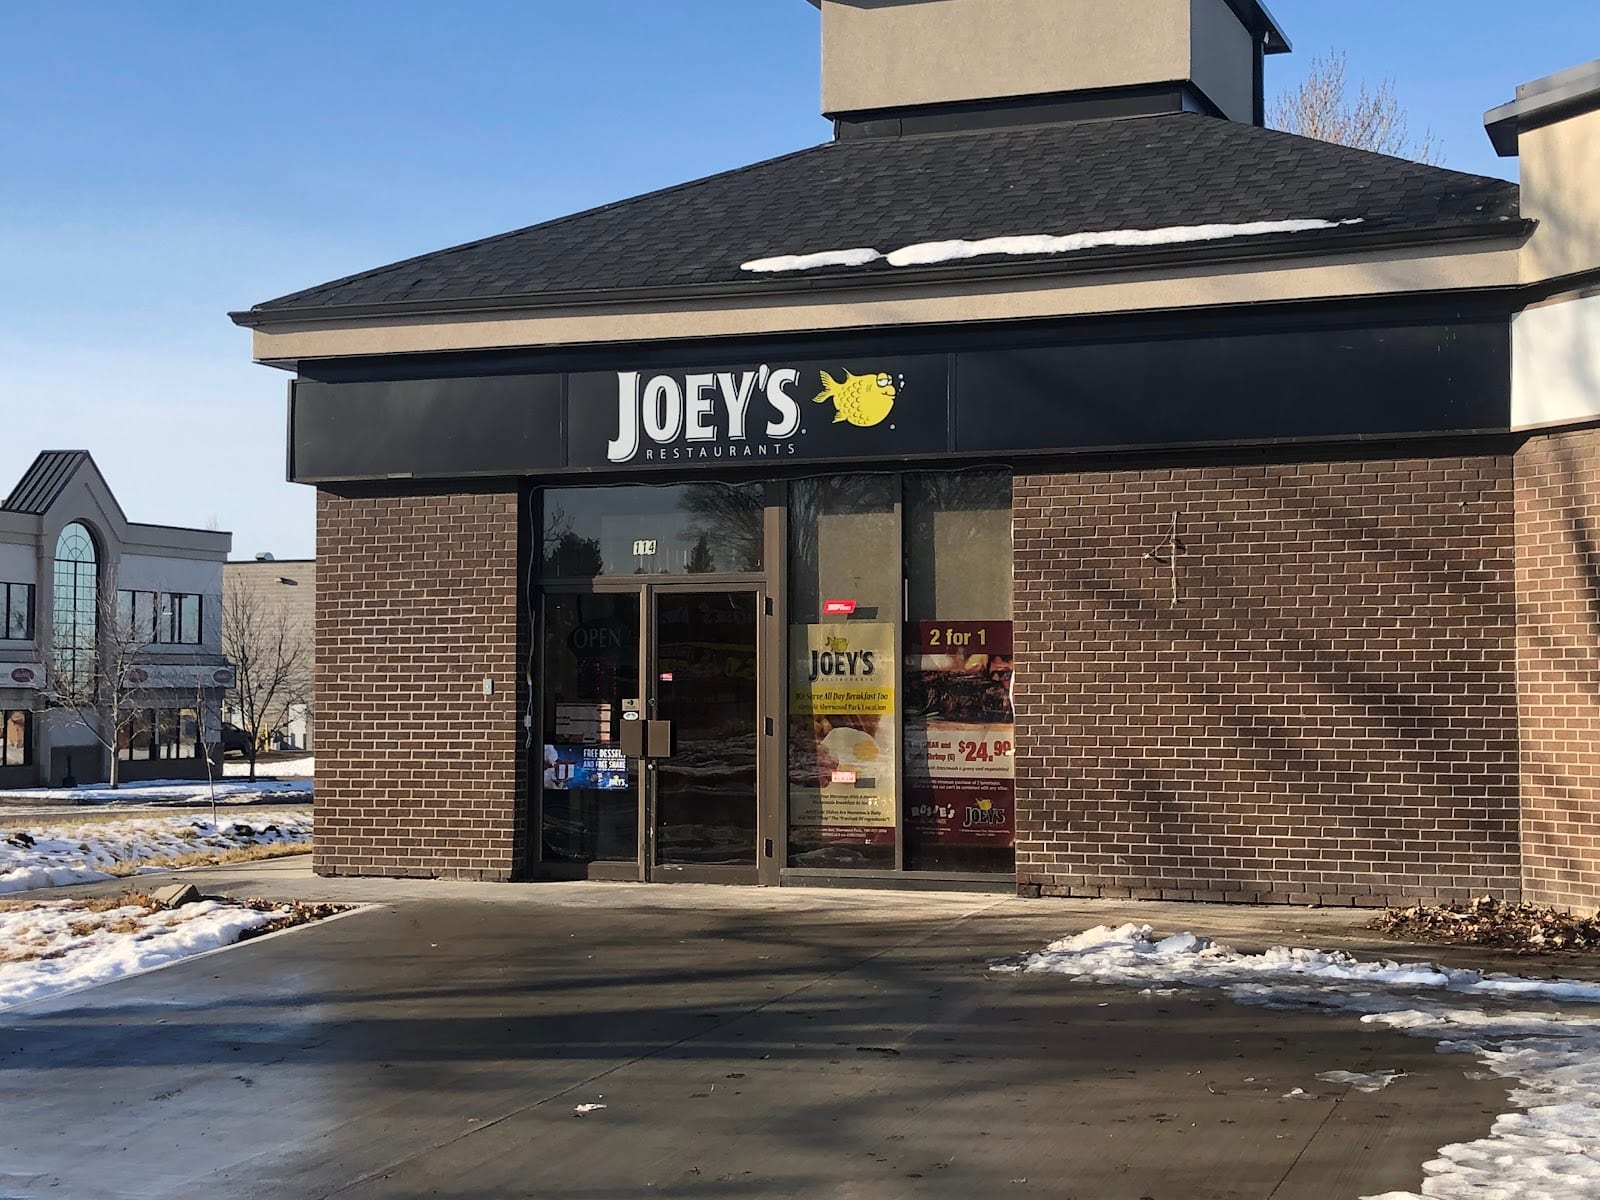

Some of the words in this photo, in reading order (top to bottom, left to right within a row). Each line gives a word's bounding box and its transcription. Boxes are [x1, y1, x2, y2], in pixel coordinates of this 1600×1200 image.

[607, 364, 801, 462] JOEY'S
[646, 443, 795, 460] RESTAURANTS
[635, 541, 655, 554] 114
[575, 627, 620, 649] OPEN
[930, 629, 940, 645] 2
[946, 629, 971, 645] for
[978, 629, 986, 645] 1
[808, 650, 874, 681] JOEY'S
[806, 692, 823, 700] Serve
[833, 692, 845, 701] Day
[846, 691, 876, 700] Breakfast
[958, 740, 1011, 762] $24.99
